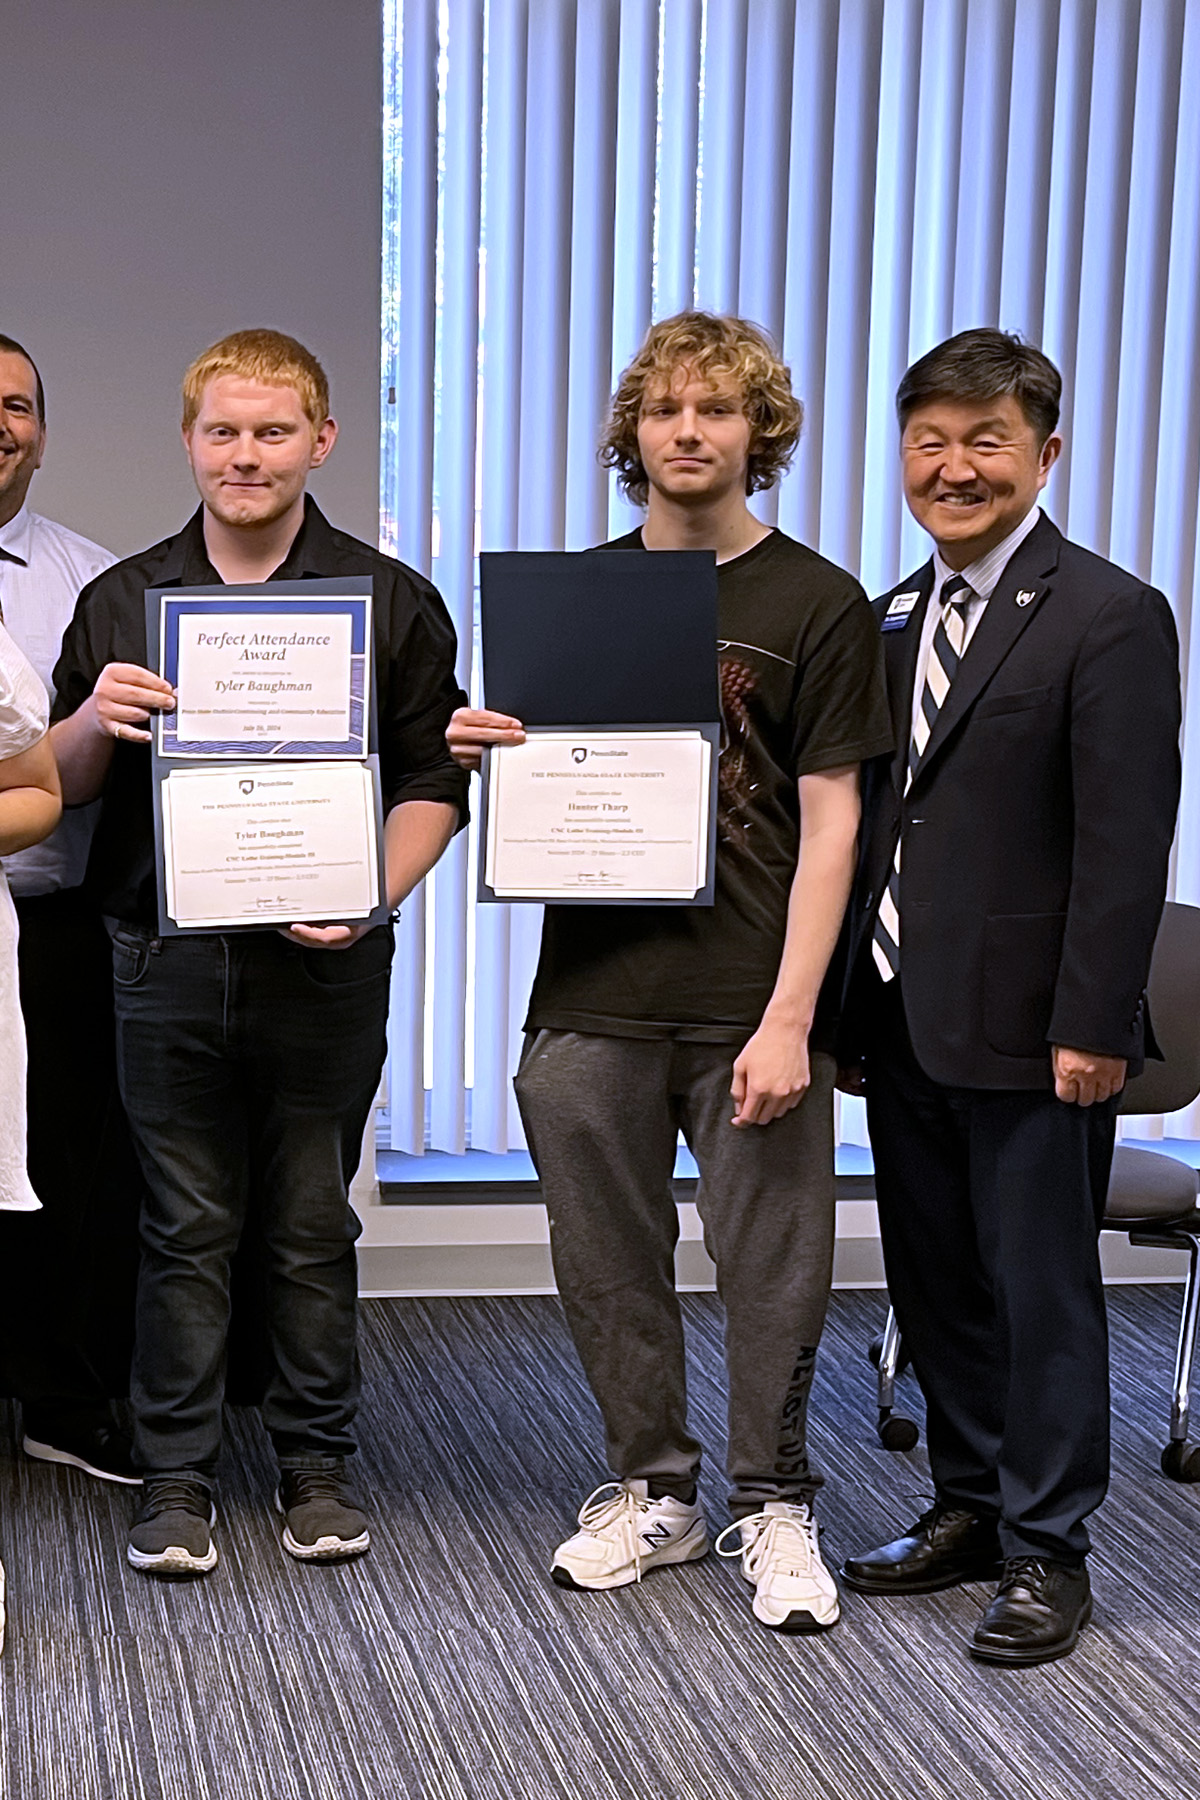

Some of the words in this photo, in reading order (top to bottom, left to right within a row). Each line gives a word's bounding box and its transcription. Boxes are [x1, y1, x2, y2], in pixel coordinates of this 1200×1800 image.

[197, 632, 245, 649] Perfect
[249, 632, 330, 645] Attendance
[239, 649, 286, 661] Award
[215, 680, 244, 693] Tyler
[247, 680, 312, 693] Baughman
[568, 803, 598, 811] Hunter
[603, 803, 628, 812] Tharp
[235, 832, 257, 840] Tyler
[260, 830, 304, 838] Baughman
